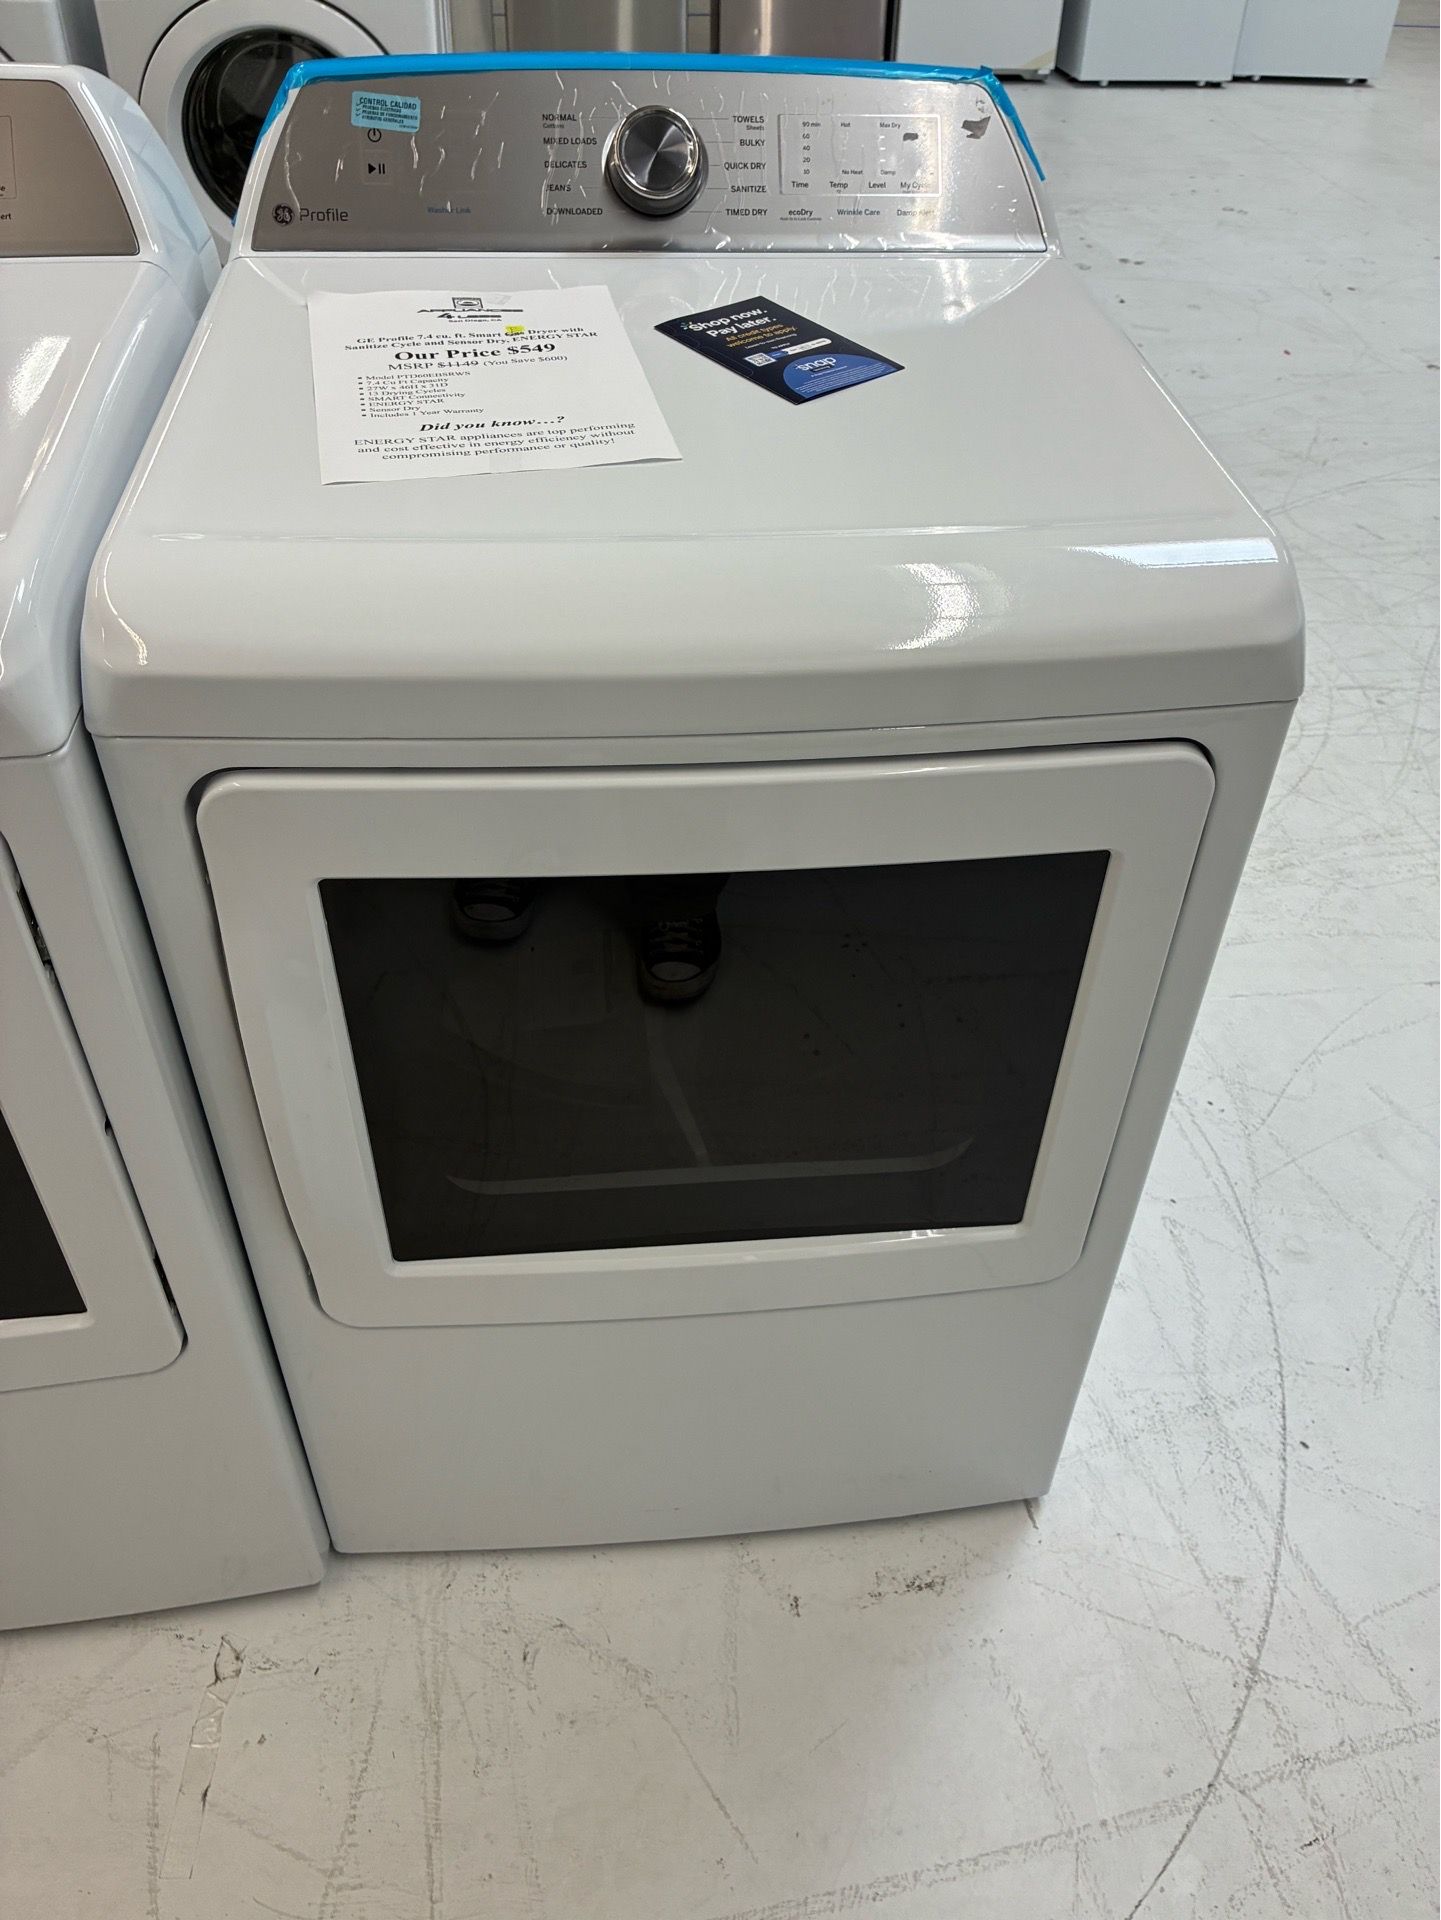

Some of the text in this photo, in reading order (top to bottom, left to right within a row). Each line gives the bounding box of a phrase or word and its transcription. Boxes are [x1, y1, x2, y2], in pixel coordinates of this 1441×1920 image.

[360, 97, 417, 110] CONTROL CALIDAD
[740, 138, 766, 146] BULKY
[724, 162, 749, 170] QUICK
[829, 182, 848, 190] Temp
[900, 182, 910, 190] My
[300, 208, 349, 222] Profile
[788, 209, 813, 217] ecoDry
[688, 309, 767, 331] Shop now.
[706, 316, 776, 337] Pay later.
[394, 344, 556, 360] Our Price $549
[797, 357, 836, 371] snap
[420, 422, 450, 431] Did
[491, 416, 564, 427] know...?
[460, 433, 522, 441] appliances
[570, 423, 636, 434] performing
[412, 443, 465, 451] effective
[528, 435, 586, 444] efficiency
[591, 430, 636, 438] without
[382, 450, 472, 460] compromising
[475, 445, 550, 456] performance
[570, 438, 615, 448] quality!
